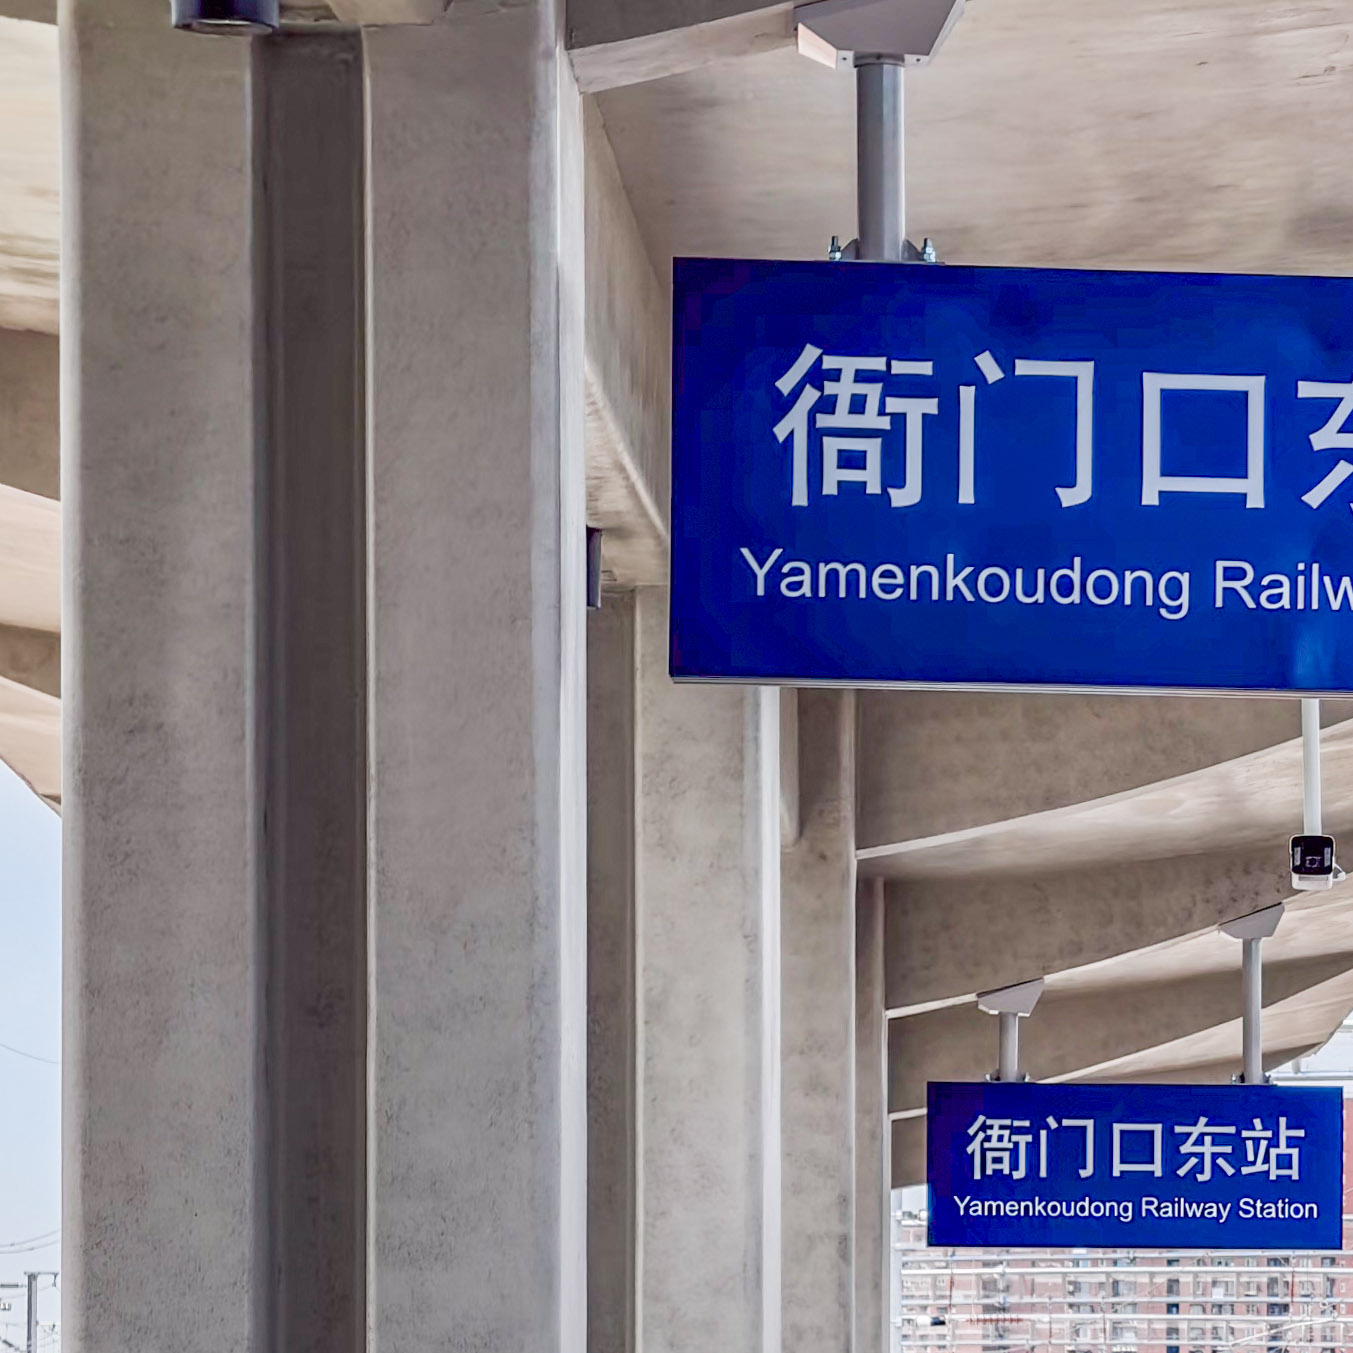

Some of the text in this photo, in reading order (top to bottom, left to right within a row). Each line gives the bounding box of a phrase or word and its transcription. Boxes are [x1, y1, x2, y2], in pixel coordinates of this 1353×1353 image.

[740, 547, 1190, 620] Yamenkoudong
[966, 1114, 1305, 1182] 衙门口东站
[953, 1195, 1318, 1223] Yamenkoudong Railway Station
